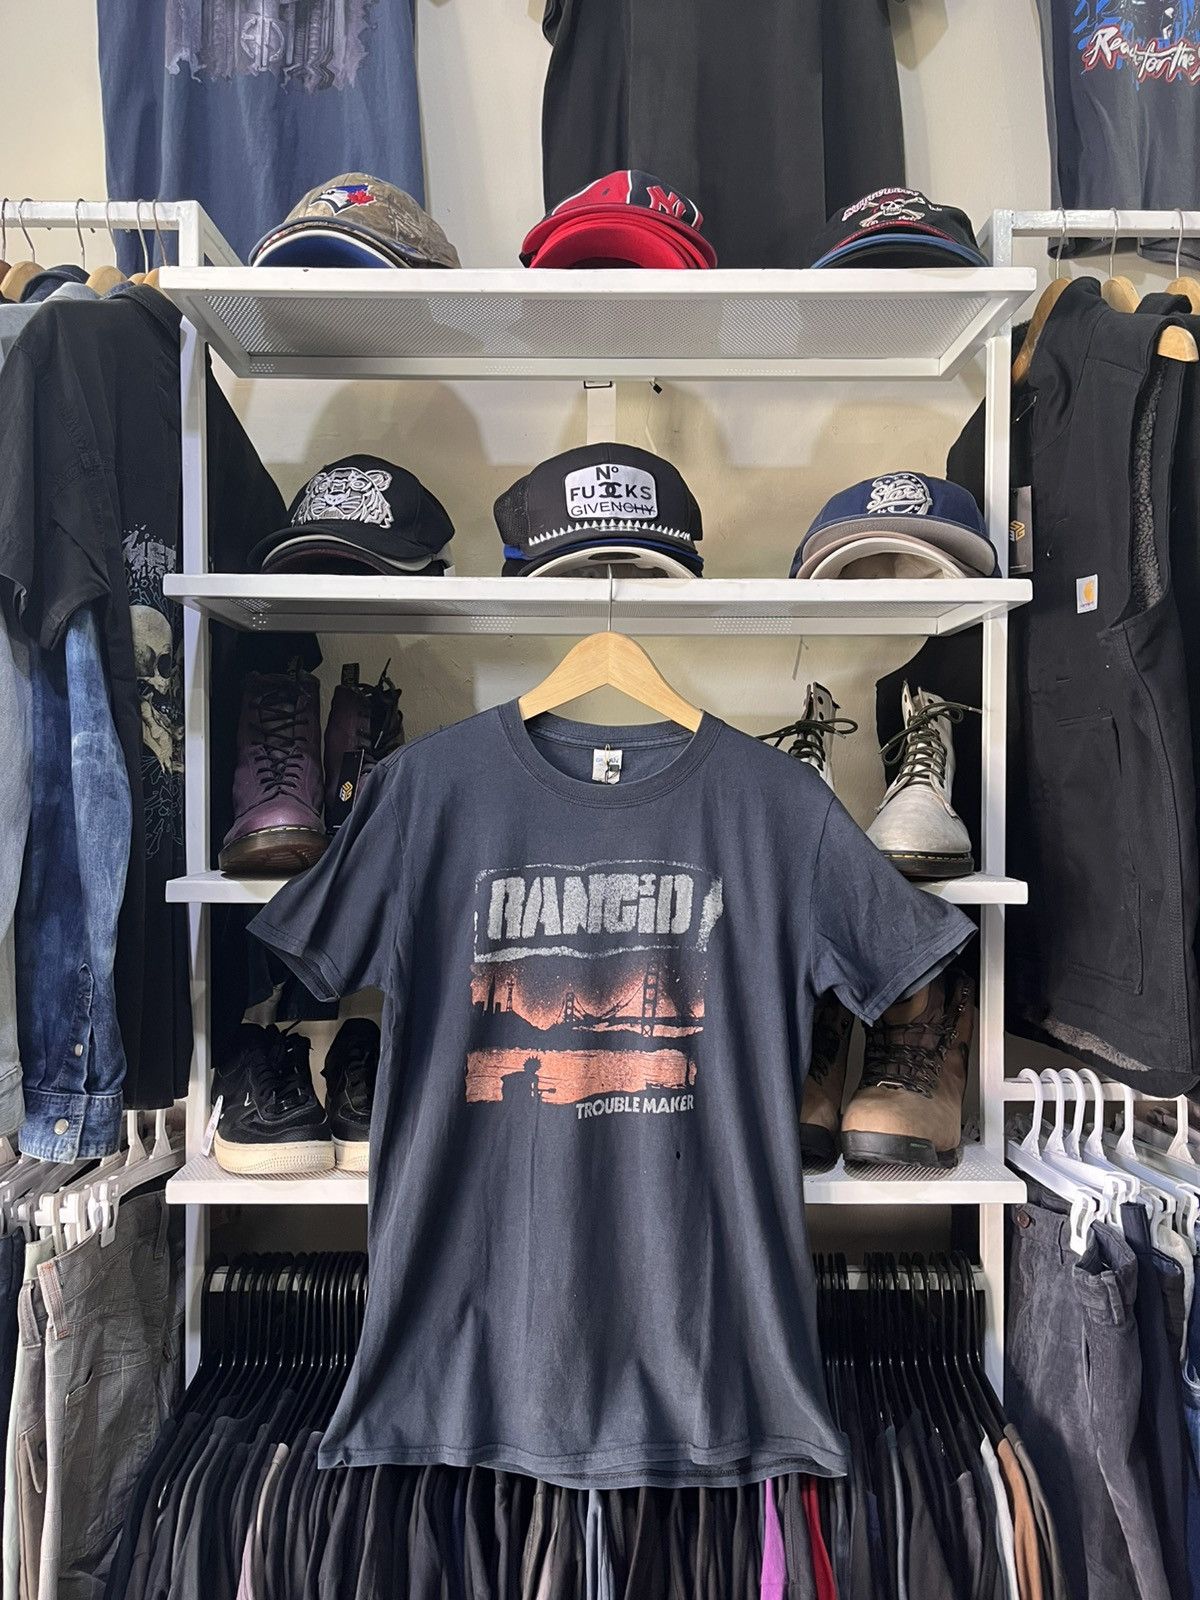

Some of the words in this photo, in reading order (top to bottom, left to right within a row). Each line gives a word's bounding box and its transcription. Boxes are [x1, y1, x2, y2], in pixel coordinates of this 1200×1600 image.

[571, 501, 655, 516] GIVENCHY
[576, 1096, 640, 1119] TROUBLE
[642, 1095, 694, 1113] MAKER
